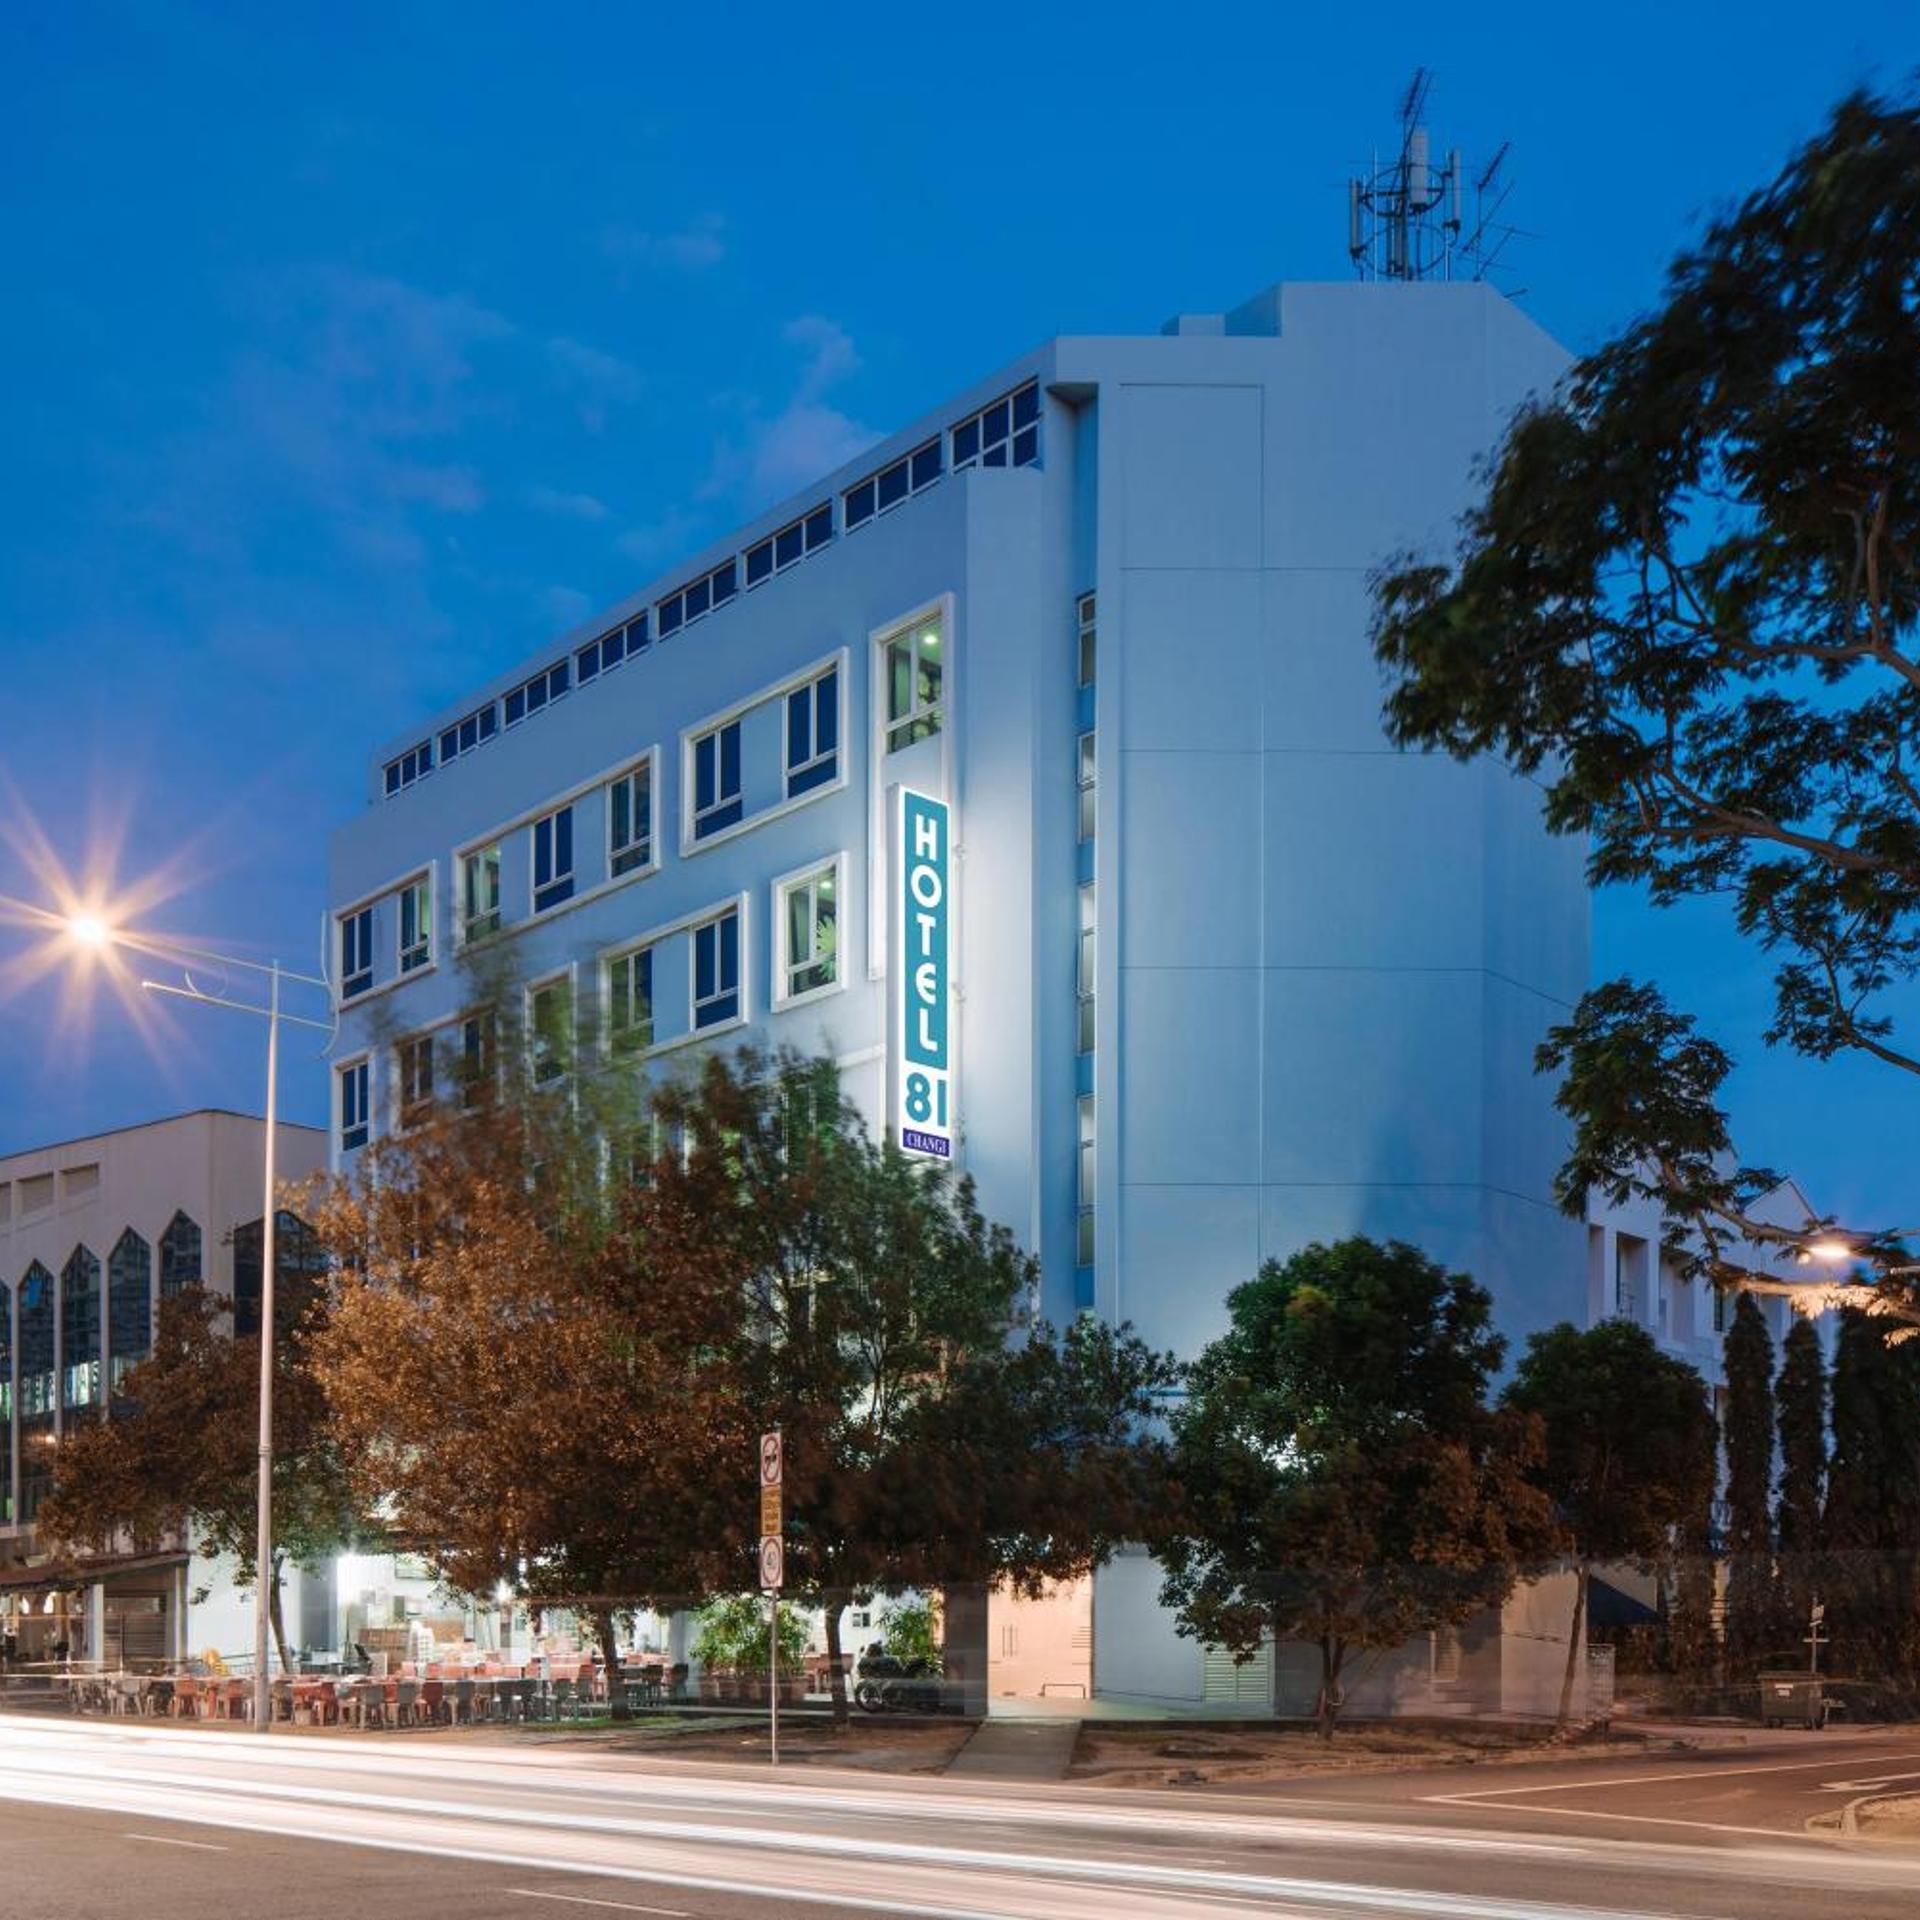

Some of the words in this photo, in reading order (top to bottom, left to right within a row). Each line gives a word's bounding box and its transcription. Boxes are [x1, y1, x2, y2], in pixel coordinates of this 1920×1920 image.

[910, 813, 943, 1053] HOTEL
[905, 1071, 948, 1127] 81
[906, 1132, 947, 1155] CHANGI
